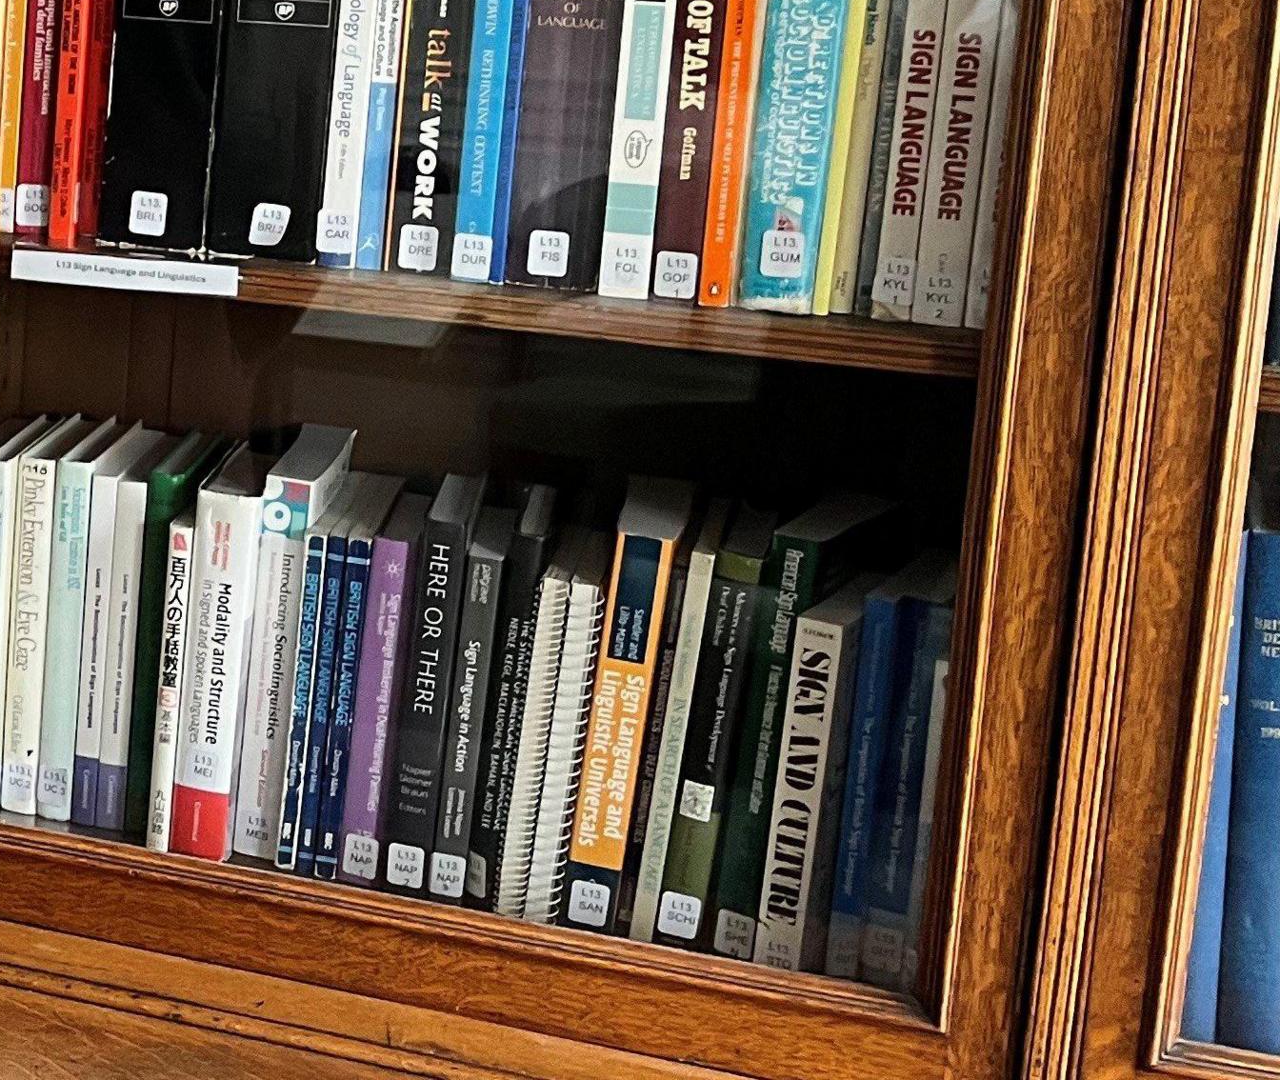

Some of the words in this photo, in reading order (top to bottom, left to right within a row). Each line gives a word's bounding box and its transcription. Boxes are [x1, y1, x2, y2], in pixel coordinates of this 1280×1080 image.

[537, 15, 607, 31] LANGUAGE
[686, 0, 714, 35] OF
[342, 44, 362, 63] of
[423, 28, 453, 91] talk
[678, 38, 711, 111] TALK
[907, 29, 937, 87] SIGN
[953, 31, 983, 90] SIGN
[335, 64, 360, 138] Language
[412, 115, 442, 221] WORK
[469, 136, 486, 196] CONTEXT
[678, 126, 698, 181] Goffman
[892, 89, 929, 217] LANGUAGE
[936, 92, 977, 222] LANGUAGE
[325, 229, 350, 240] CAR
[408, 246, 433, 257] DRE
[56, 260, 72, 270] L13
[73, 261, 92, 272] Sign
[94, 264, 137, 277] Language
[138, 269, 156, 278] and
[157, 270, 206, 283] Linguistics
[460, 254, 487, 265] DUR
[541, 251, 561, 262] FIS
[614, 263, 639, 274] FOL
[769, 251, 801, 263] GUM
[883, 279, 908, 291] KYL
[23, 476, 45, 518] Pinky
[20, 521, 44, 586] Extension
[426, 543, 451, 600] HERE
[272, 552, 295, 633] Introducing
[303, 572, 320, 621] BRITISH
[344, 580, 363, 632] BRITISH
[210, 583, 232, 647] Modality
[421, 607, 444, 640] OR
[299, 622, 316, 653] SIGN
[341, 632, 358, 661] SIGN
[464, 640, 481, 665] Sign
[211, 648, 226, 676] and
[412, 647, 440, 716] THERE
[265, 634, 288, 740] Sociolinguistics
[457, 666, 478, 721] Language
[620, 673, 646, 716] Sign
[793, 647, 833, 723] SIGN
[590, 670, 622, 755] Linguistic
[193, 766, 213, 778] MEI
[454, 736, 471, 773] Action
[606, 718, 638, 808] Language
[578, 756, 609, 849] Universals
[602, 808, 625, 841] and
[350, 854, 373, 865] NAP
[394, 862, 418, 874] NAP
[436, 872, 460, 883] NAP
[758, 798, 812, 931] CULTURE
[578, 901, 604, 914] SAN
